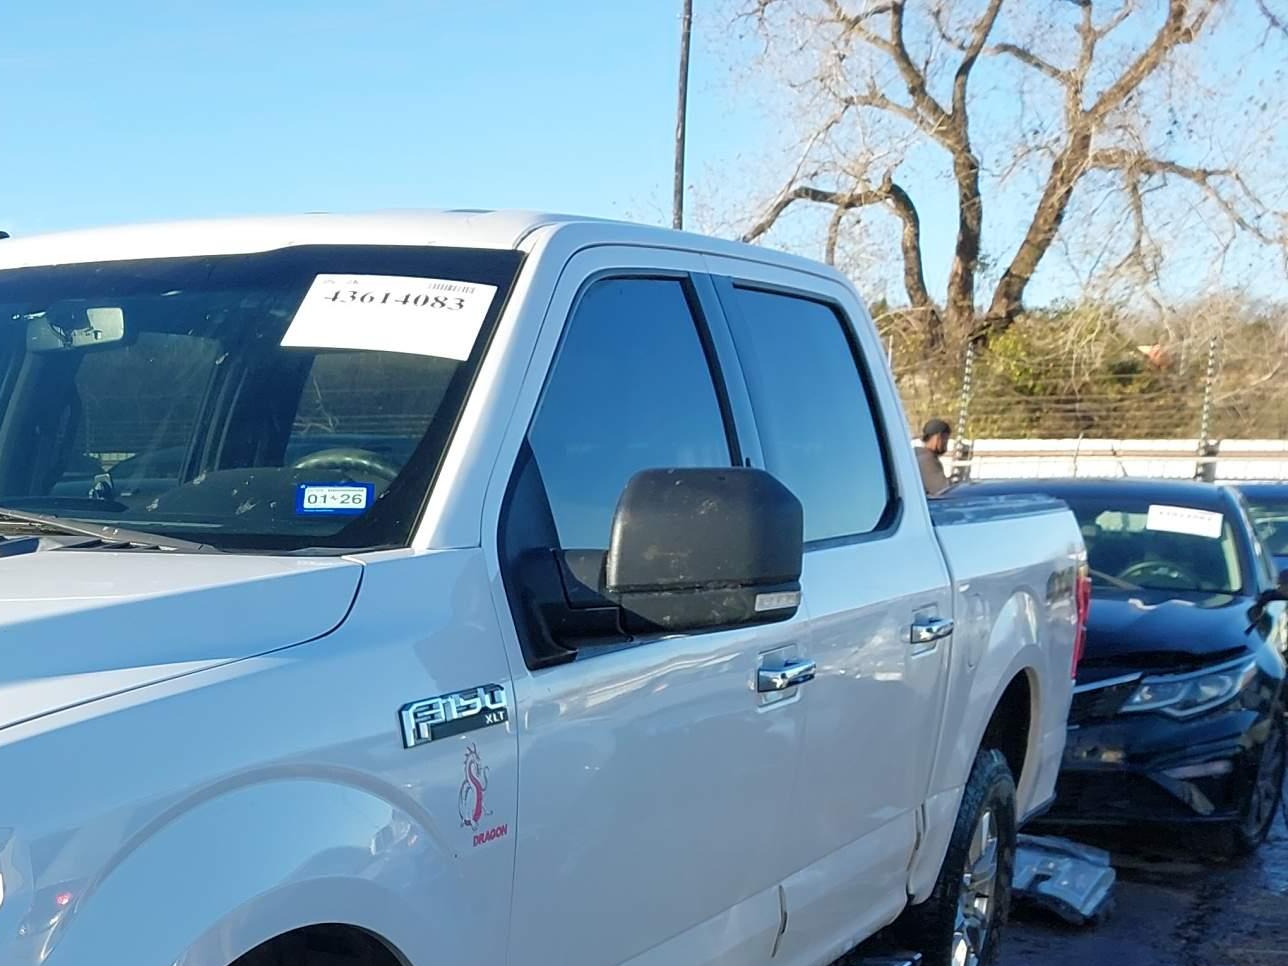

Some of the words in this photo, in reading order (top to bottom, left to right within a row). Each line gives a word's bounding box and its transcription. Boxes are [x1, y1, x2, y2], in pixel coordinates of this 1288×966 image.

[324, 290, 465, 311] 43614083
[484, 710, 506, 725] XLT
[472, 823, 508, 848] DRAGON
